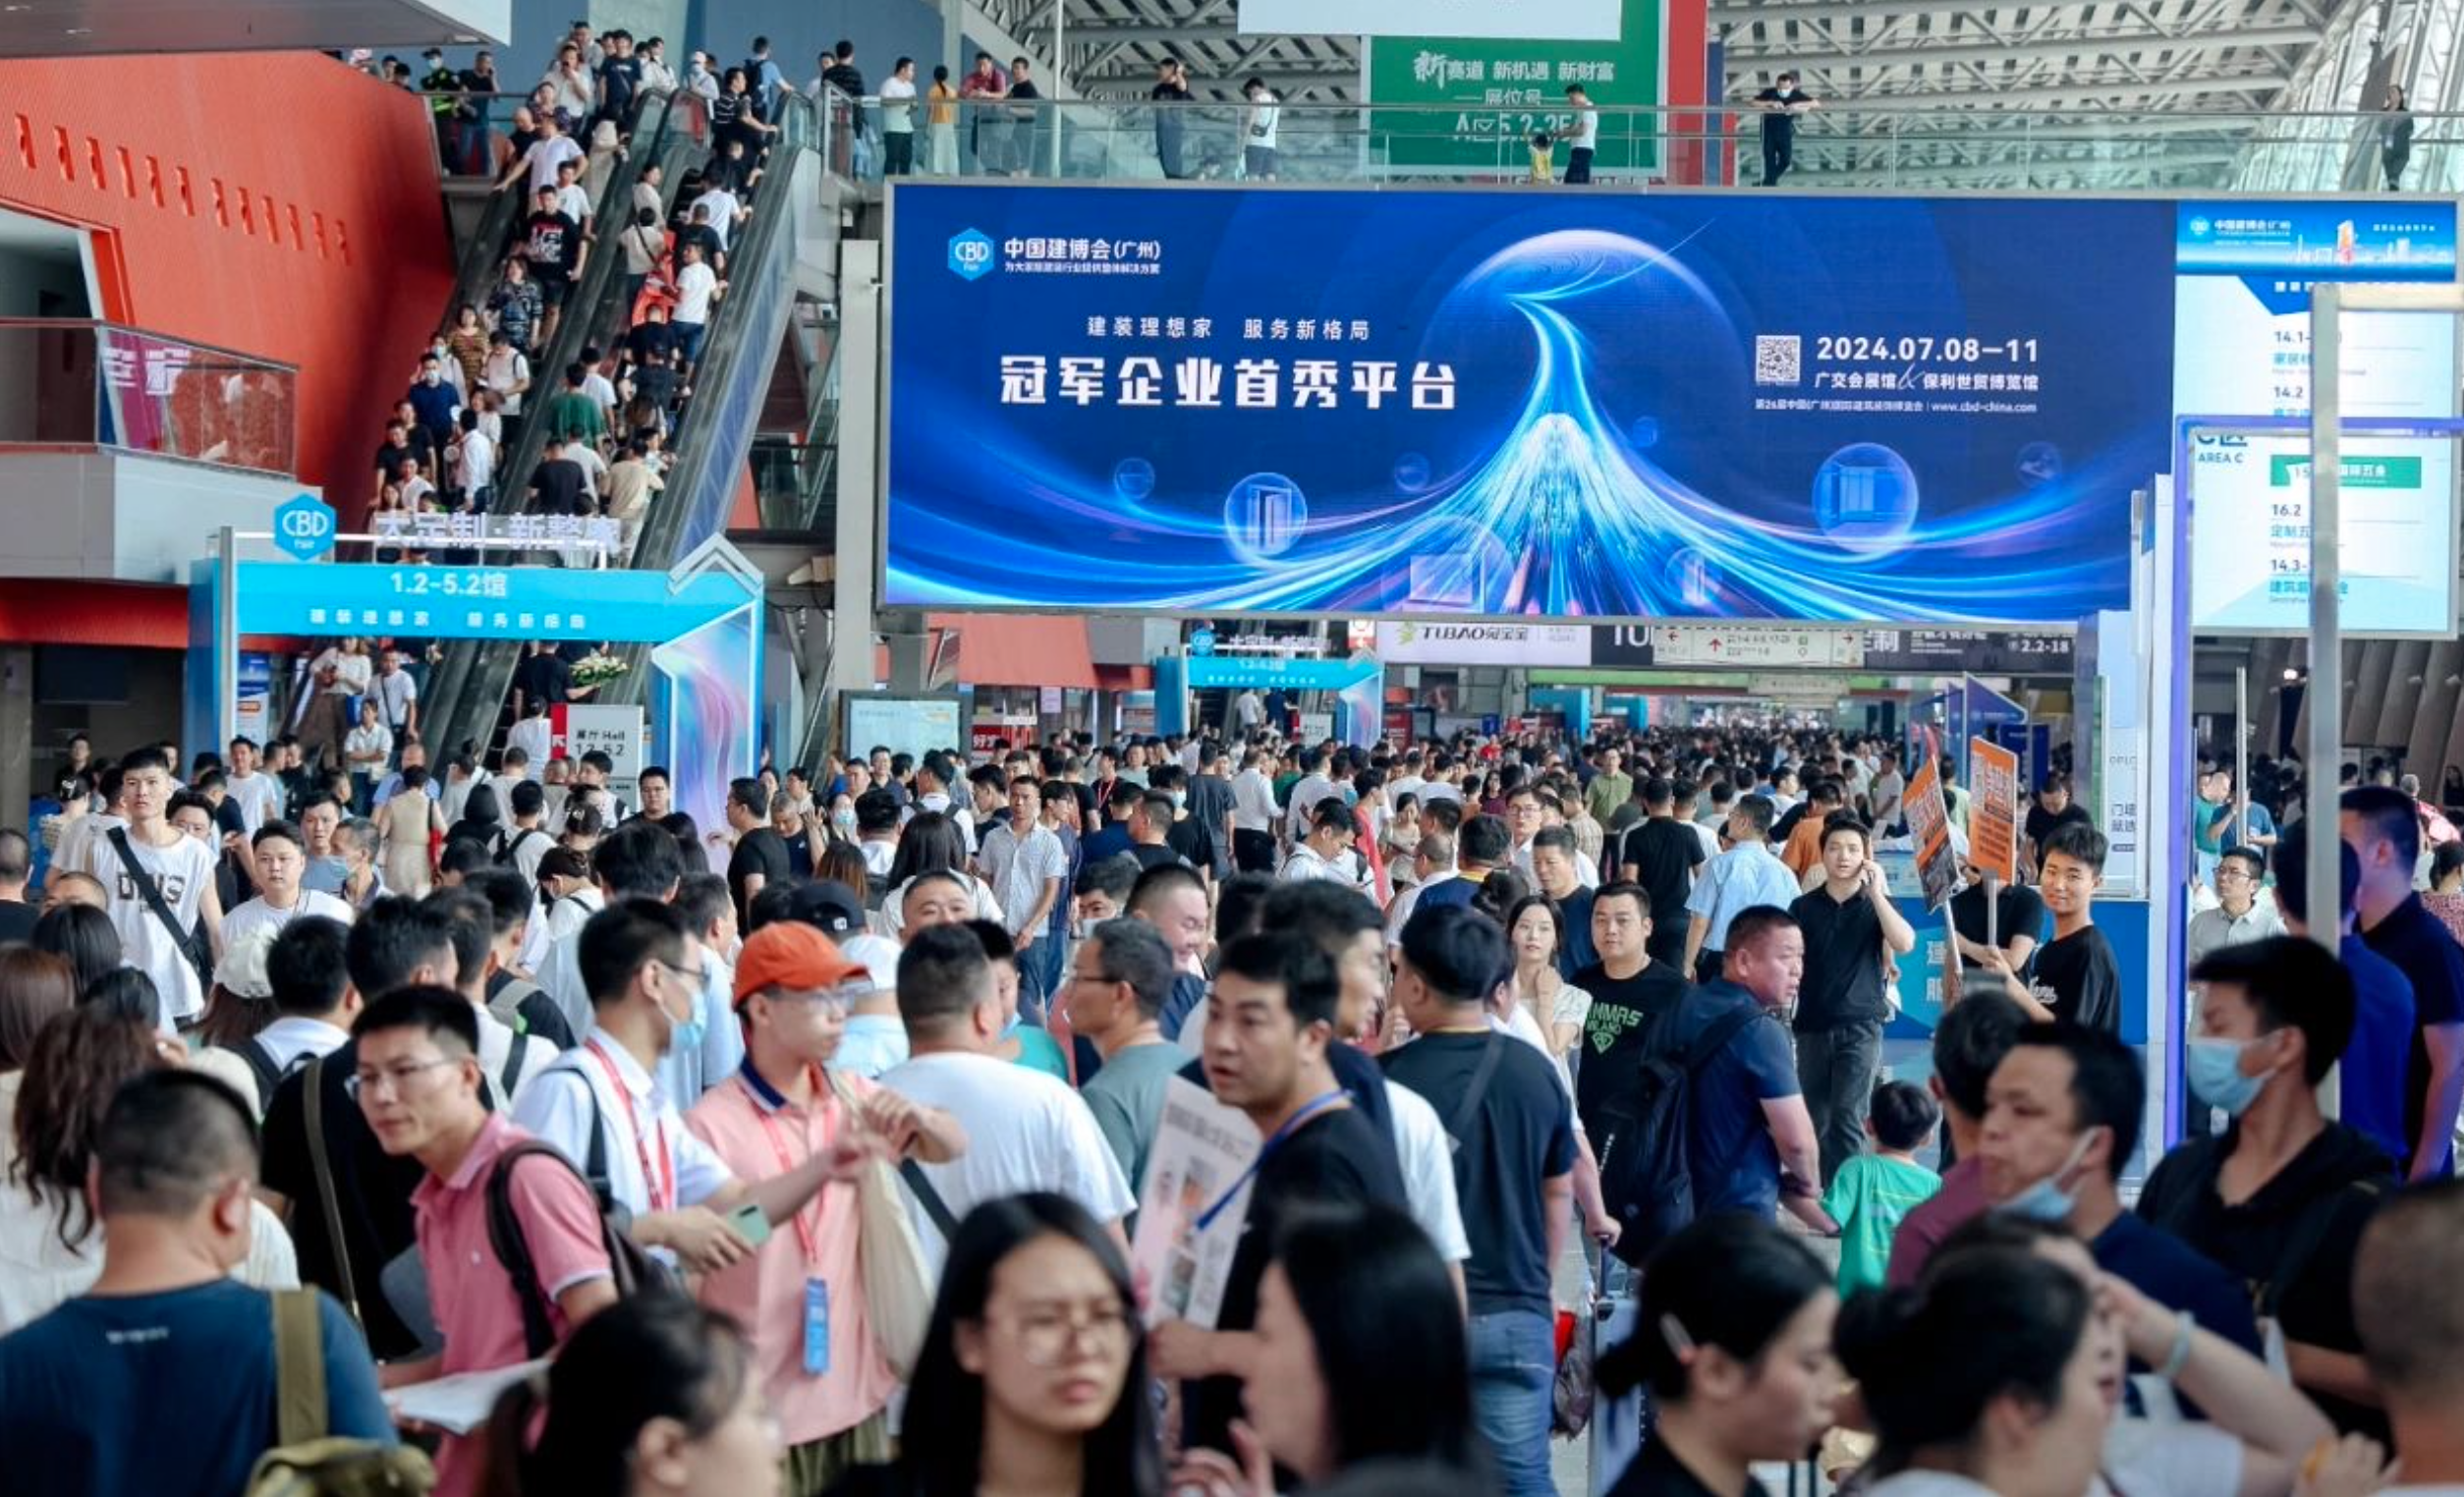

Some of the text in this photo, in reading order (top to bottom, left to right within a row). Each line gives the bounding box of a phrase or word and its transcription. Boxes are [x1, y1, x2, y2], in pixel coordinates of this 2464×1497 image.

[1414, 50, 1614, 89] 新赛道 新机遇 新财富
[955, 242, 988, 262] CBD
[1005, 238, 1161, 259] 中国建博会(广州)
[1087, 316, 1371, 341] 建装理想家 服务新格局
[1000, 355, 1457, 410] 冠军企业首秀平台
[2274, 386, 2303, 398] 14.2
[2198, 453, 2244, 464] AREA C
[2271, 504, 2302, 517] 16.2
[282, 510, 328, 537] CBD
[390, 572, 507, 598] 1.2-5.2馆
[601, 730, 626, 741] Hall
